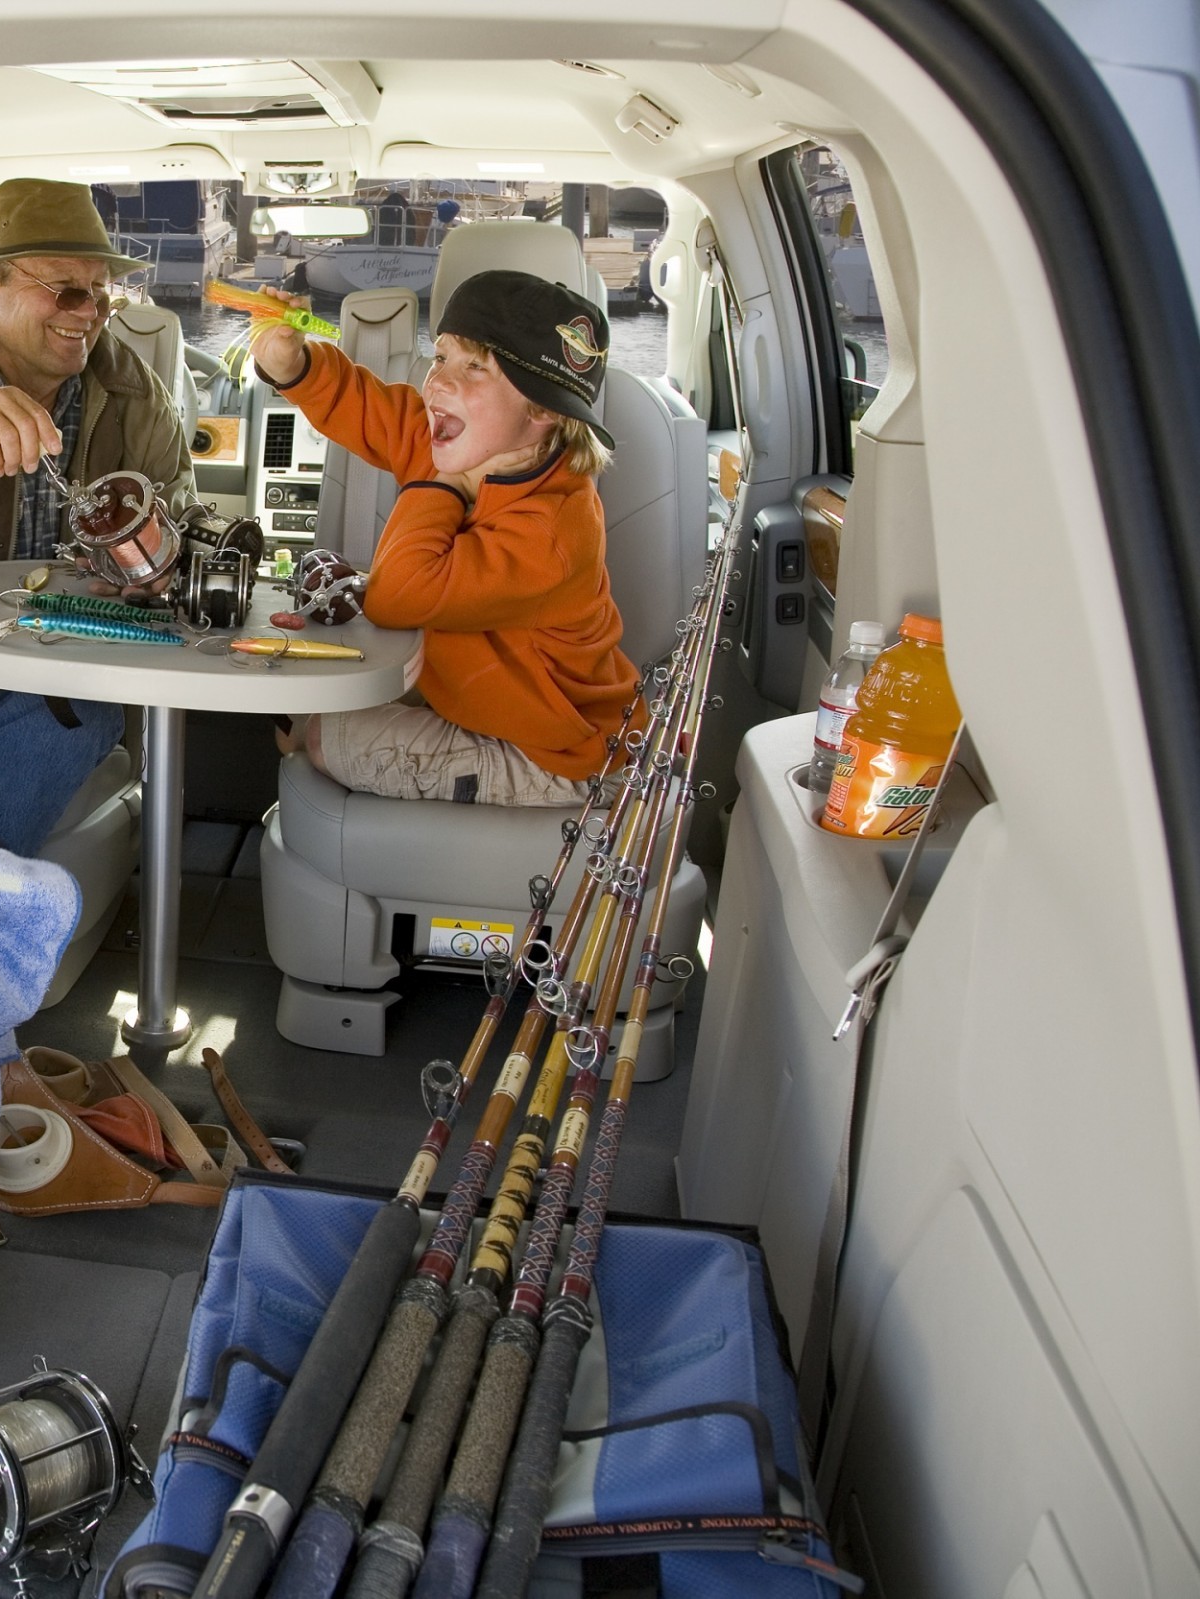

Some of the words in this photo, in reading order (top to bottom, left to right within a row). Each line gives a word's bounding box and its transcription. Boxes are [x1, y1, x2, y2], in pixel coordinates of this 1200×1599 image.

[540, 354, 559, 368] SANTA
[879, 786, 937, 806] Gator
[618, 1520, 682, 1534] CALIFORNIA
[700, 1516, 776, 1529] INNOVATIONS
[543, 1525, 615, 1538] INNOVATIONS
